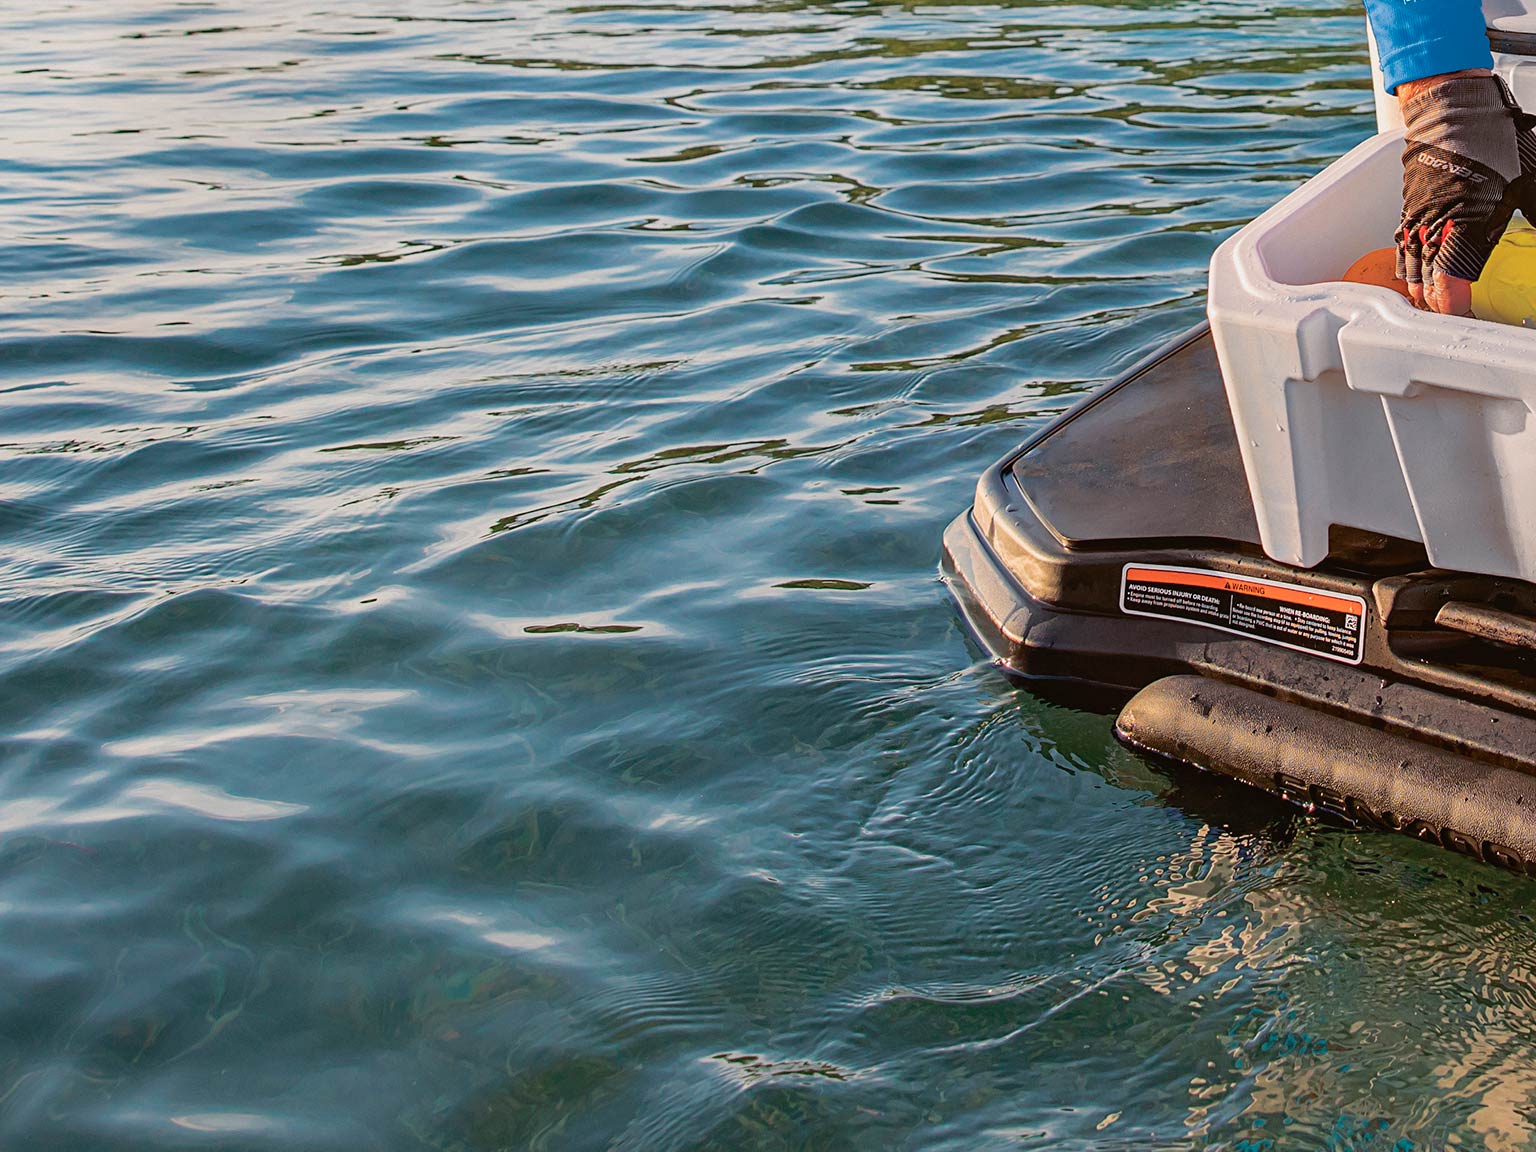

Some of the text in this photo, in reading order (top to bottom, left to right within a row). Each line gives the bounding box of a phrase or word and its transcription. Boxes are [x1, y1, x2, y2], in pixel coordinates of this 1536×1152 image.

[1232, 582, 1265, 595] WARNING
[1148, 587, 1171, 595] SERIOUS
[1173, 591, 1192, 599] INJURY
[1202, 595, 1220, 604] DEATH:
[1279, 606, 1294, 615] WHEN
